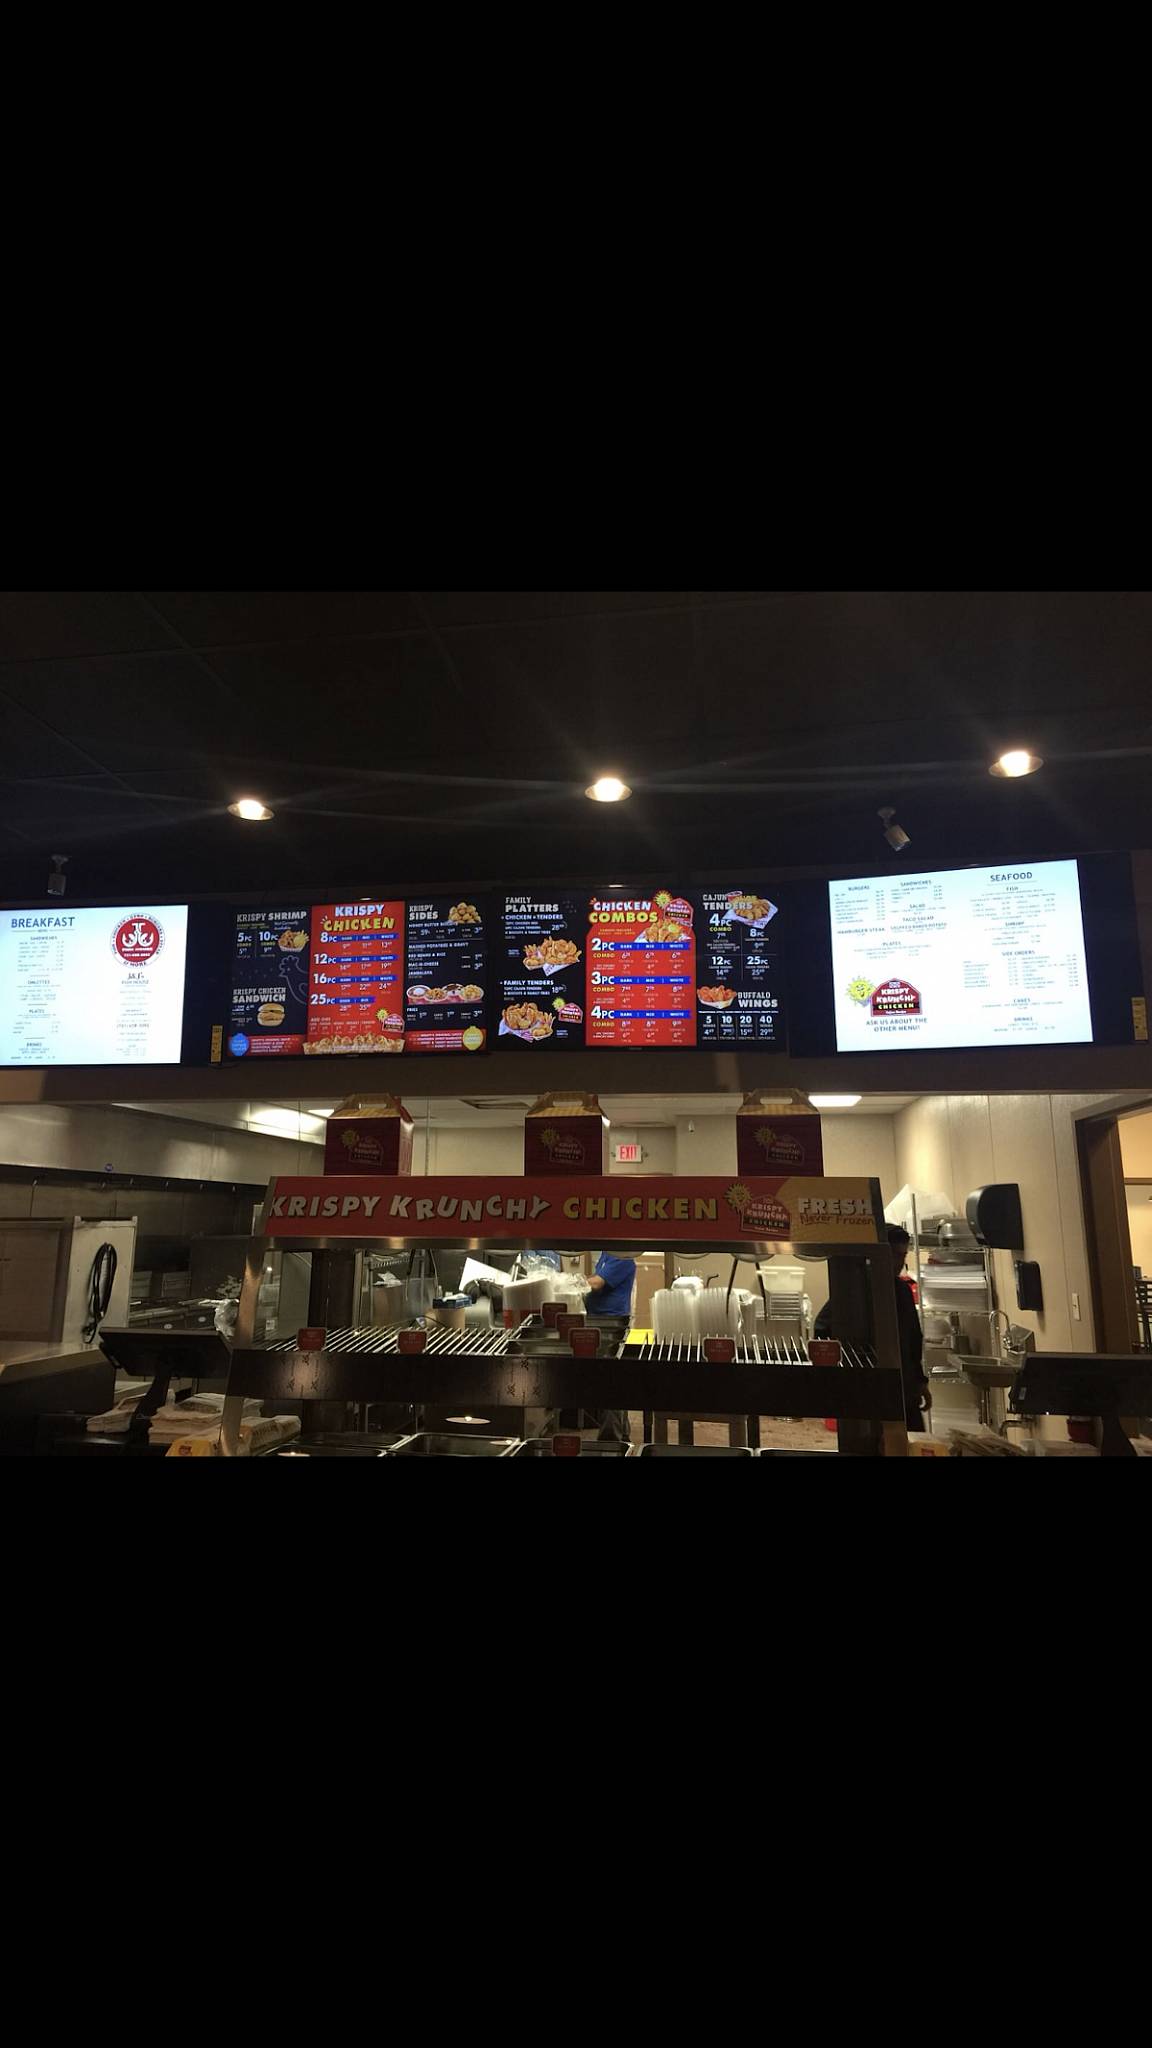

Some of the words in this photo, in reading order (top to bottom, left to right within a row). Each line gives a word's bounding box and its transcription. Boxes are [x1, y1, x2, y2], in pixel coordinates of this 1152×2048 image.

[990, 872, 1033, 882] SEAFOOD
[335, 904, 385, 916] KRISPY
[409, 904, 434, 912] KRISPY
[505, 904, 559, 913] PLATTERS
[593, 901, 651, 911] CHICKEN
[703, 902, 753, 911] TENDERS
[237, 913, 266, 922] KRISPY
[268, 911, 307, 921] SHRIMP
[409, 911, 438, 920] SIDES
[589, 912, 658, 922] COMBOS
[11, 916, 76, 929] BREAKFAST
[323, 917, 395, 931] CHICKEN
[232, 994, 286, 1003] SANDWICH
[738, 999, 778, 1008] WINGS
[706, 1015, 712, 1024] 5
[722, 1015, 733, 1024] 10
[740, 1015, 752, 1024] 20
[760, 1015, 773, 1024] 40
[620, 1146, 637, 1160] EXIT
[269, 1195, 381, 1218] KRISPY
[389, 1194, 551, 1221] KRUNCHY
[563, 1197, 719, 1220] CHICKEN
[751, 1203, 783, 1212] KRISPY
[799, 1197, 873, 1215] FRESH
[801, 1213, 831, 1226] Never
[836, 1214, 874, 1225] Frozen
